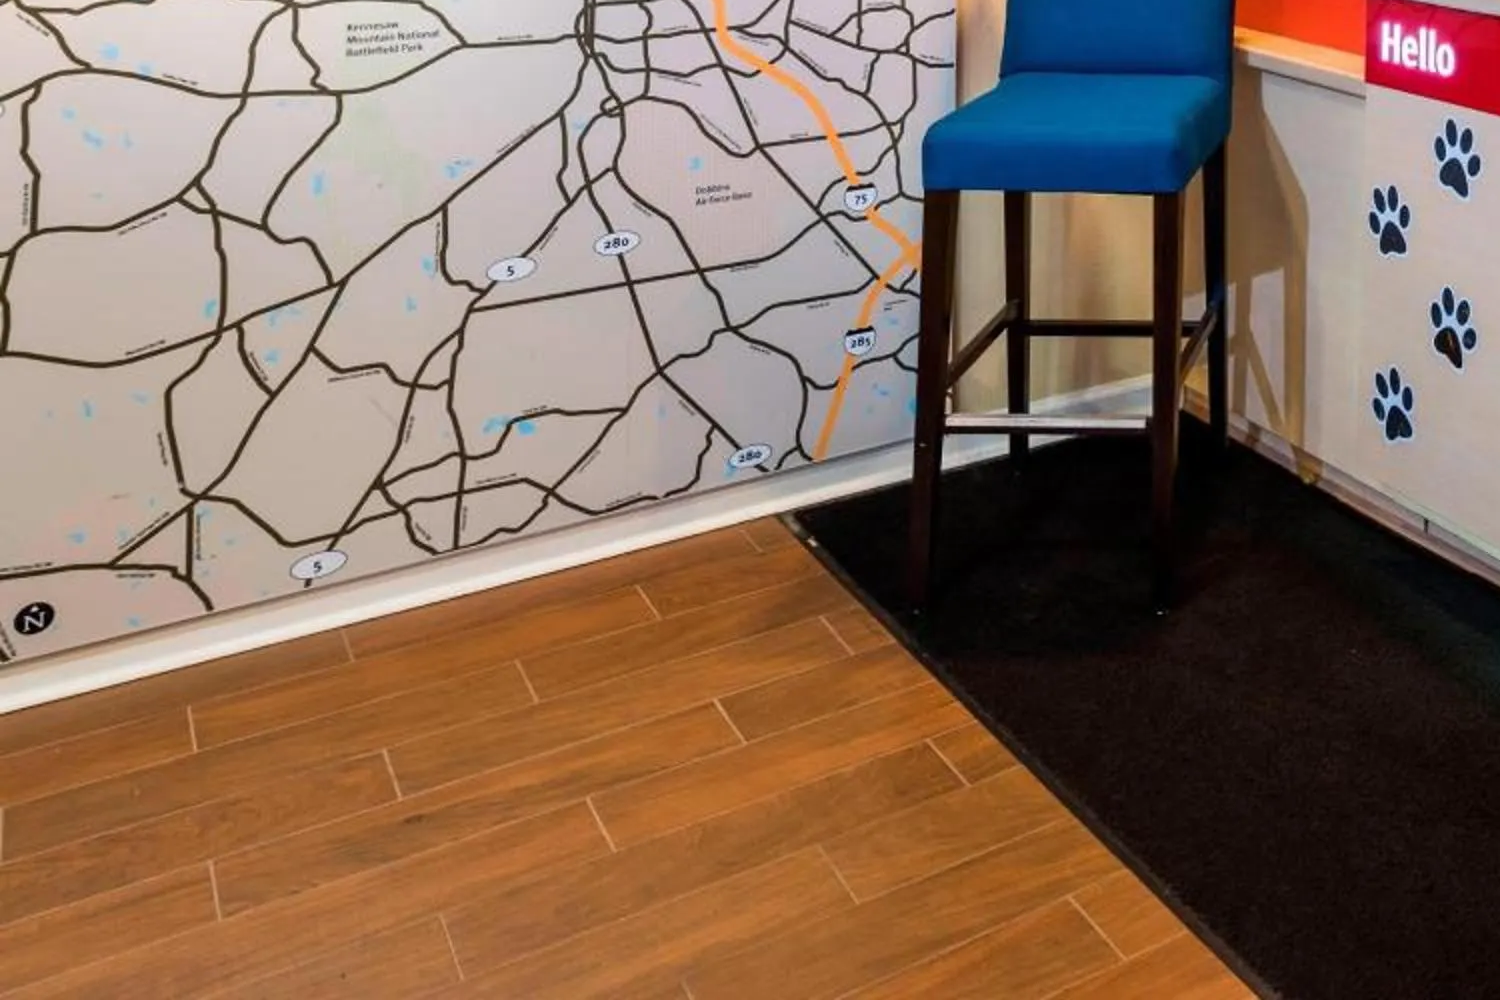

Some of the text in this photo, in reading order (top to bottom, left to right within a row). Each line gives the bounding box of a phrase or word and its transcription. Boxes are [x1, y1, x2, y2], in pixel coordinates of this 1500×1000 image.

[1380, 21, 1455, 78] Hello
[854, 194, 868, 205] 75
[603, 237, 630, 250] 280
[506, 265, 515, 277] 5
[850, 336, 872, 349] 285
[739, 450, 764, 463] 280
[312, 561, 323, 572] 5
[22, 610, 46, 633] N
